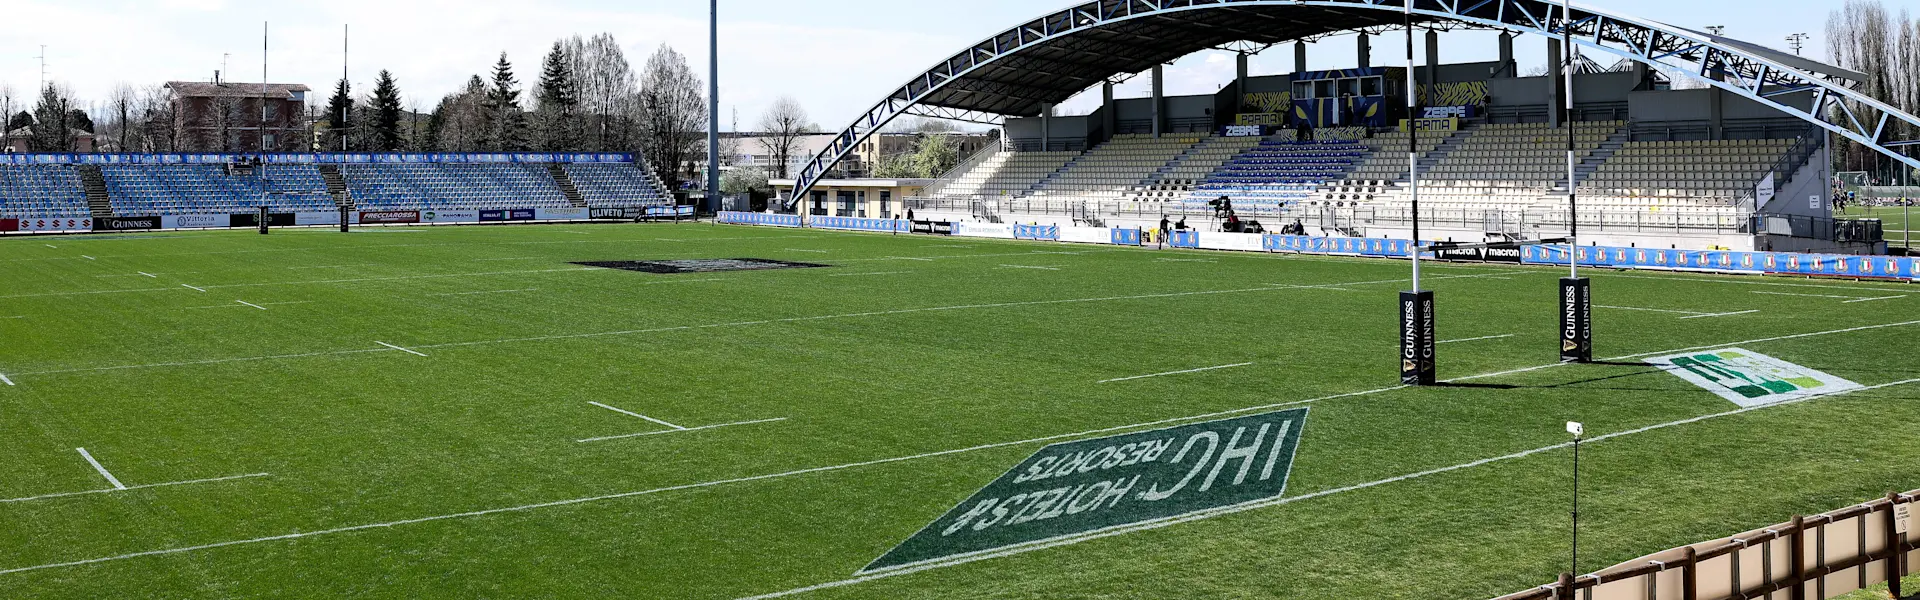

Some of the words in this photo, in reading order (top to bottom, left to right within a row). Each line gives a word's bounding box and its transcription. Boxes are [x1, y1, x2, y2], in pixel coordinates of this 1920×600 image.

[1241, 113, 1277, 125] PARMA
[1423, 106, 1466, 118] ZEBRE
[1225, 125, 1260, 136] ZEBRE
[112, 220, 152, 228] GUINNESS
[591, 208, 622, 218] ULIVETO
[1488, 248, 1519, 257] macron
[1565, 285, 1576, 339] GUINNESS
[1404, 300, 1415, 359] GUINNESS
[1422, 299, 1432, 359] GUINNESS
[1013, 437, 1174, 484] RESORTS
[1143, 419, 1291, 501] IHG
[973, 474, 1141, 532] HOTELS
